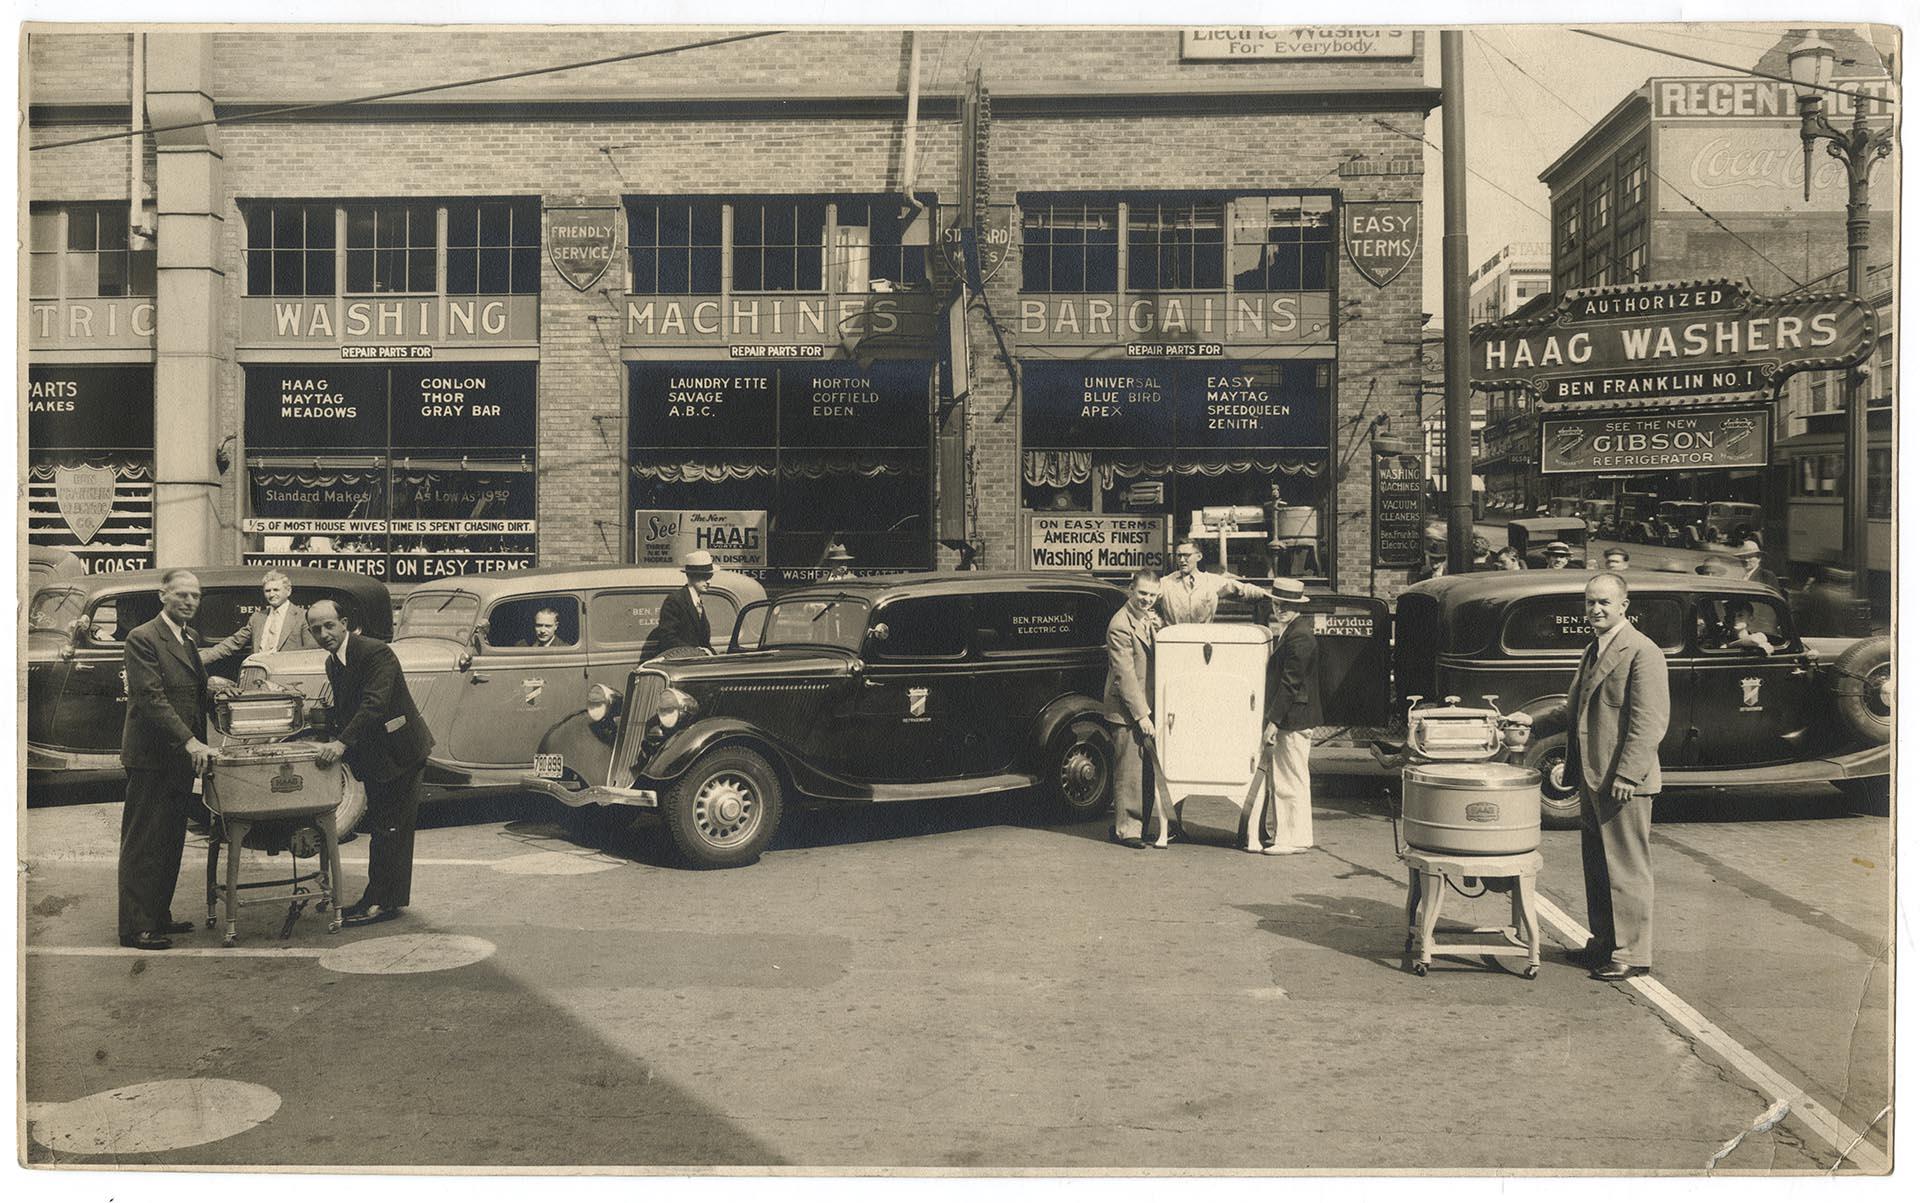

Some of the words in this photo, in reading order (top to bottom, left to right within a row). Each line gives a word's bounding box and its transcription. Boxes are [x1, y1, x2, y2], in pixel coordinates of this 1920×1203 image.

[1229, 42, 1264, 54] For
[1275, 40, 1376, 55] Everybody.
[1662, 82, 1797, 115] REGENT
[1353, 216, 1412, 233] EASY
[552, 226, 614, 238] FRIENDLY
[554, 246, 609, 260] SERVICE
[1351, 239, 1411, 257] TERMS
[1585, 290, 1722, 315] AUTHORIZED
[274, 302, 507, 336] WASHING
[626, 300, 898, 334] MACHINES
[1020, 298, 1321, 333] BARGAINS.
[1485, 332, 1593, 371] HAAG
[1621, 312, 1838, 360] WASHERS
[342, 347, 377, 358] REPAIR
[379, 347, 408, 357] PARTS
[411, 346, 431, 357] FOR
[732, 346, 766, 356] REPAIR
[768, 346, 797, 356] PARTS
[800, 346, 821, 356] FOR
[1128, 345, 1163, 355] REPAIR
[1166, 345, 1196, 355] PARTS
[1199, 344, 1220, 355] FOR
[282, 379, 329, 391] HAAG
[421, 378, 486, 389] CONLON
[670, 378, 730, 389] LAUNDRY
[734, 378, 767, 389] ETTE
[813, 378, 871, 389] HORTON
[1084, 377, 1161, 389] UNIVERSAL
[1207, 377, 1255, 388] EASY
[1559, 381, 1594, 396] BEN
[1603, 374, 1703, 394] FRANKLIN
[1712, 373, 1742, 387] NO.
[282, 394, 344, 404] MAYTAG
[422, 392, 464, 403] THOR
[668, 392, 723, 403] SAVAGE
[813, 393, 879, 403] COFFIELD
[1084, 392, 1119, 403] BLUE
[1128, 392, 1161, 403] BIRD
[1207, 391, 1268, 402] MAYTAG
[282, 407, 357, 418] MEADOWS
[421, 406, 464, 417] GRAY
[472, 405, 501, 416] BAR
[669, 406, 716, 417] A.B.C.
[1081, 406, 1122, 417] APEX
[1207, 405, 1290, 416] SPEEDQUEEN
[1208, 418, 1263, 429] ZENITH.
[1606, 422, 1631, 432] SEE
[1636, 420, 1661, 431] THE
[1666, 419, 1697, 429] NEW
[1592, 430, 1715, 452] GIBSON
[1593, 452, 1713, 466] REFRIGERATOR
[1379, 469, 1420, 480] WASHING
[1380, 482, 1420, 492] MACHINES
[266, 489, 320, 502] Standard
[325, 490, 370, 502] Makes
[1382, 500, 1417, 510] VACUUM
[690, 513, 705, 522] The
[706, 513, 727, 522] New
[1380, 512, 1420, 521] CLEANERS
[268, 522, 281, 531] OF
[284, 521, 312, 531] MOST
[315, 521, 345, 531] HOUSE
[350, 521, 386, 531] WIVES
[391, 522, 413, 531] TIME
[416, 522, 426, 531] IS
[429, 522, 461, 531] SPENT
[464, 522, 504, 531] CHASING
[507, 522, 532, 531] DIRT.
[646, 513, 682, 541] See!
[1040, 520, 1066, 529] ON
[1067, 519, 1105, 530] EASY
[1110, 519, 1156, 529] TERMS
[696, 527, 759, 549] HAAG
[1044, 531, 1105, 543] AMERICA'S
[1111, 531, 1151, 543] FINEST
[723, 554, 760, 563] DISPLAY
[1032, 548, 1093, 569] Washing
[1097, 548, 1163, 567] Machines
[94, 558, 147, 574] COAST
[308, 560, 386, 575] CLEANERS
[396, 560, 420, 575] ON
[423, 560, 467, 575] EASY
[1031, 614, 1074, 624] FRANKLIN
[1017, 626, 1056, 634] ELECTRIC
